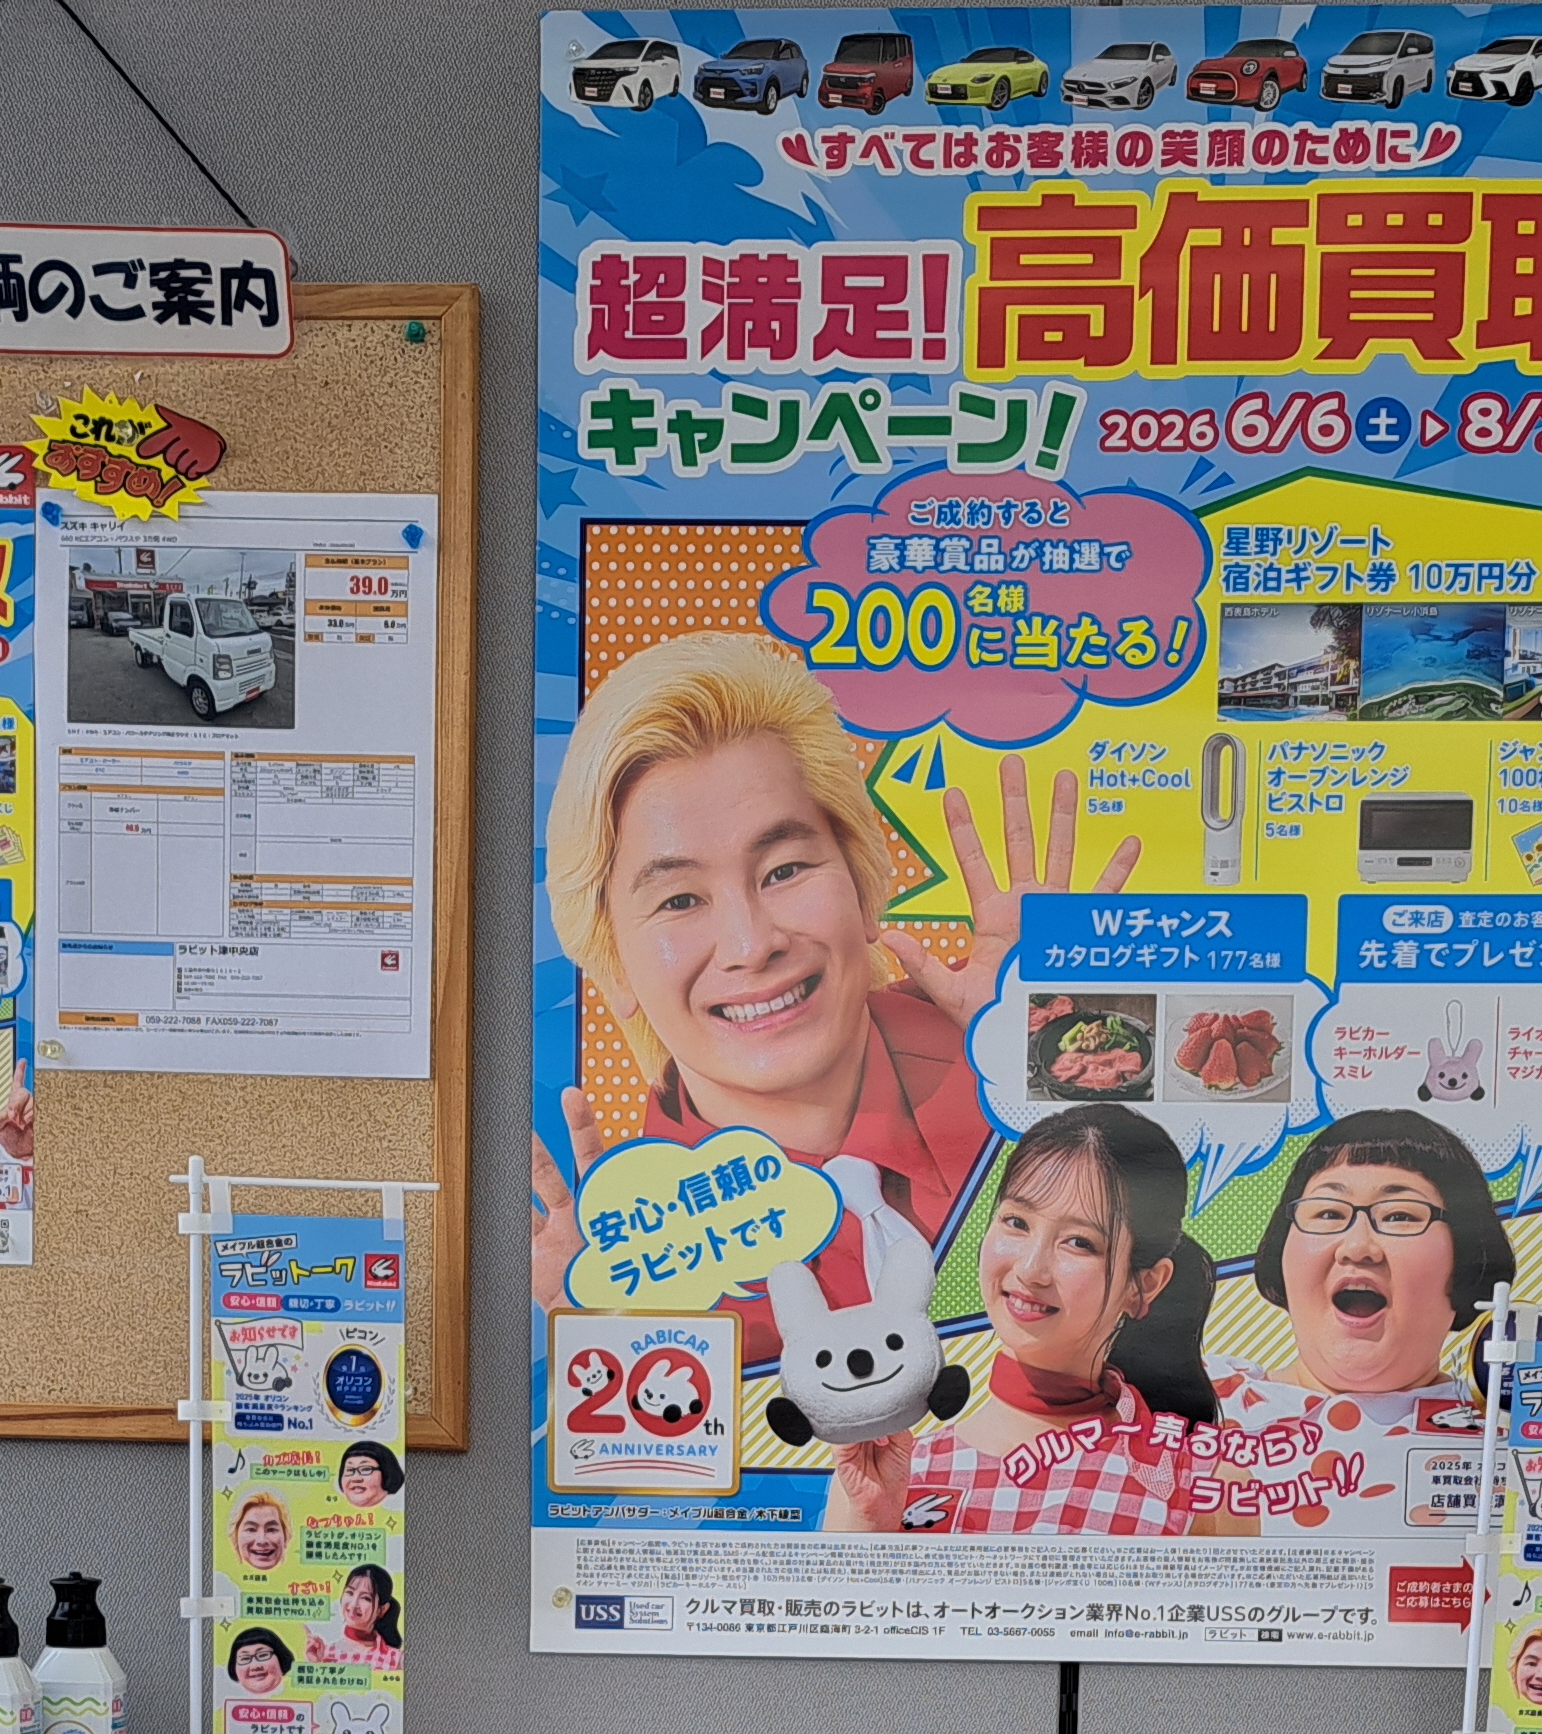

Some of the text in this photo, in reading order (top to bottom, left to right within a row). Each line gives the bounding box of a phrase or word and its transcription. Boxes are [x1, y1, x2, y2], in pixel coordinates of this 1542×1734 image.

[818, 127, 1414, 172] すべてはお客様の笑顔のために
[1104, 413, 1214, 448] 2026
[909, 498, 1069, 529] ご成約すると
[61, 521, 87, 532] スズキ
[1223, 526, 1393, 558] 星野リゾート
[868, 538, 1128, 573] 豪華賞品が抽選で
[349, 575, 389, 596] 39.0
[807, 586, 1025, 670] 200 名様
[1088, 741, 1167, 762] ダイソン
[1267, 740, 1386, 762] パナソニック
[1089, 767, 1191, 790] Hot+Cool
[1267, 767, 1409, 788] オーブンレンジ
[1087, 798, 1124, 814] 5名様
[1267, 792, 1344, 813] ビストロ
[1265, 823, 1302, 838] 5名様
[1390, 910, 1447, 930] ご来店
[1045, 943, 1281, 971] カタログギフト 177名様
[1334, 1026, 1390, 1041] ラビカー
[1334, 1046, 1421, 1061] キーホルダー
[1334, 1065, 1373, 1080] スミレ
[610, 1206, 790, 1298] ラビットです
[229, 1325, 379, 1343] お知らせです ピコン
[630, 1329, 709, 1355] RABICAR
[335, 1376, 372, 1386] オリコン
[287, 1417, 313, 1430] No.1
[599, 1443, 718, 1457] ANNIVERSARY
[1431, 1462, 1472, 1470] 2025年
[580, 1605, 621, 1621] USS
[960, 1627, 981, 1636] TEL
[250, 1724, 305, 1734] ラビットです
